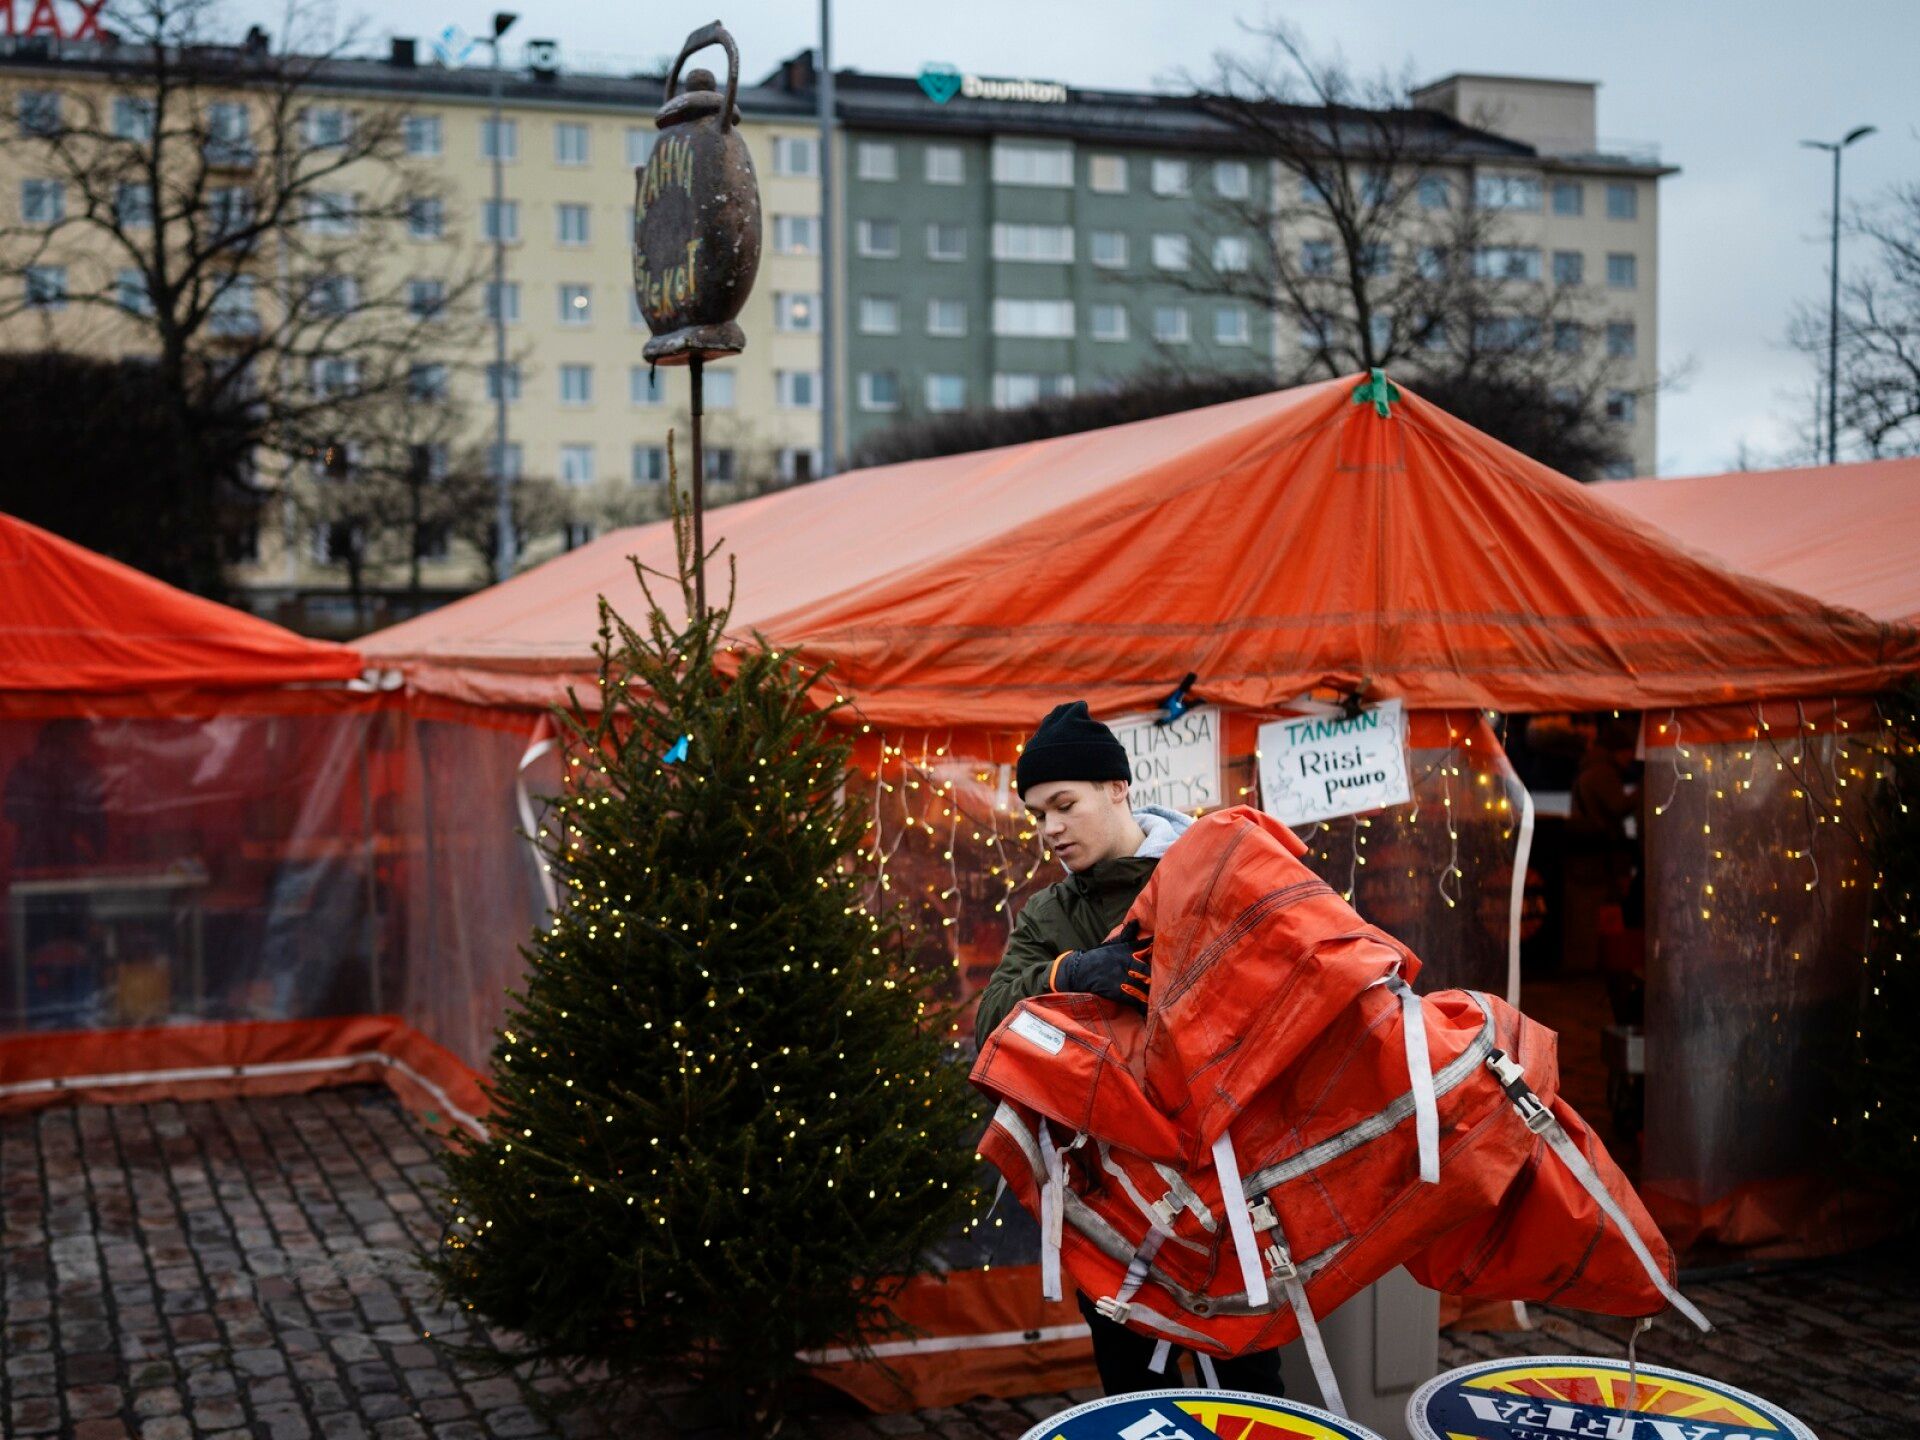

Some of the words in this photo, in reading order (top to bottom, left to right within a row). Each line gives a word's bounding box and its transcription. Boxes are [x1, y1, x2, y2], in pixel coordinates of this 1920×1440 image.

[1134, 756, 1170, 782] ON
[1299, 745, 1376, 778] Riisi-
[1126, 773, 1210, 809] MMITYS
[1324, 770, 1386, 805] puuro
[1458, 1393, 1776, 1440] AFFA
